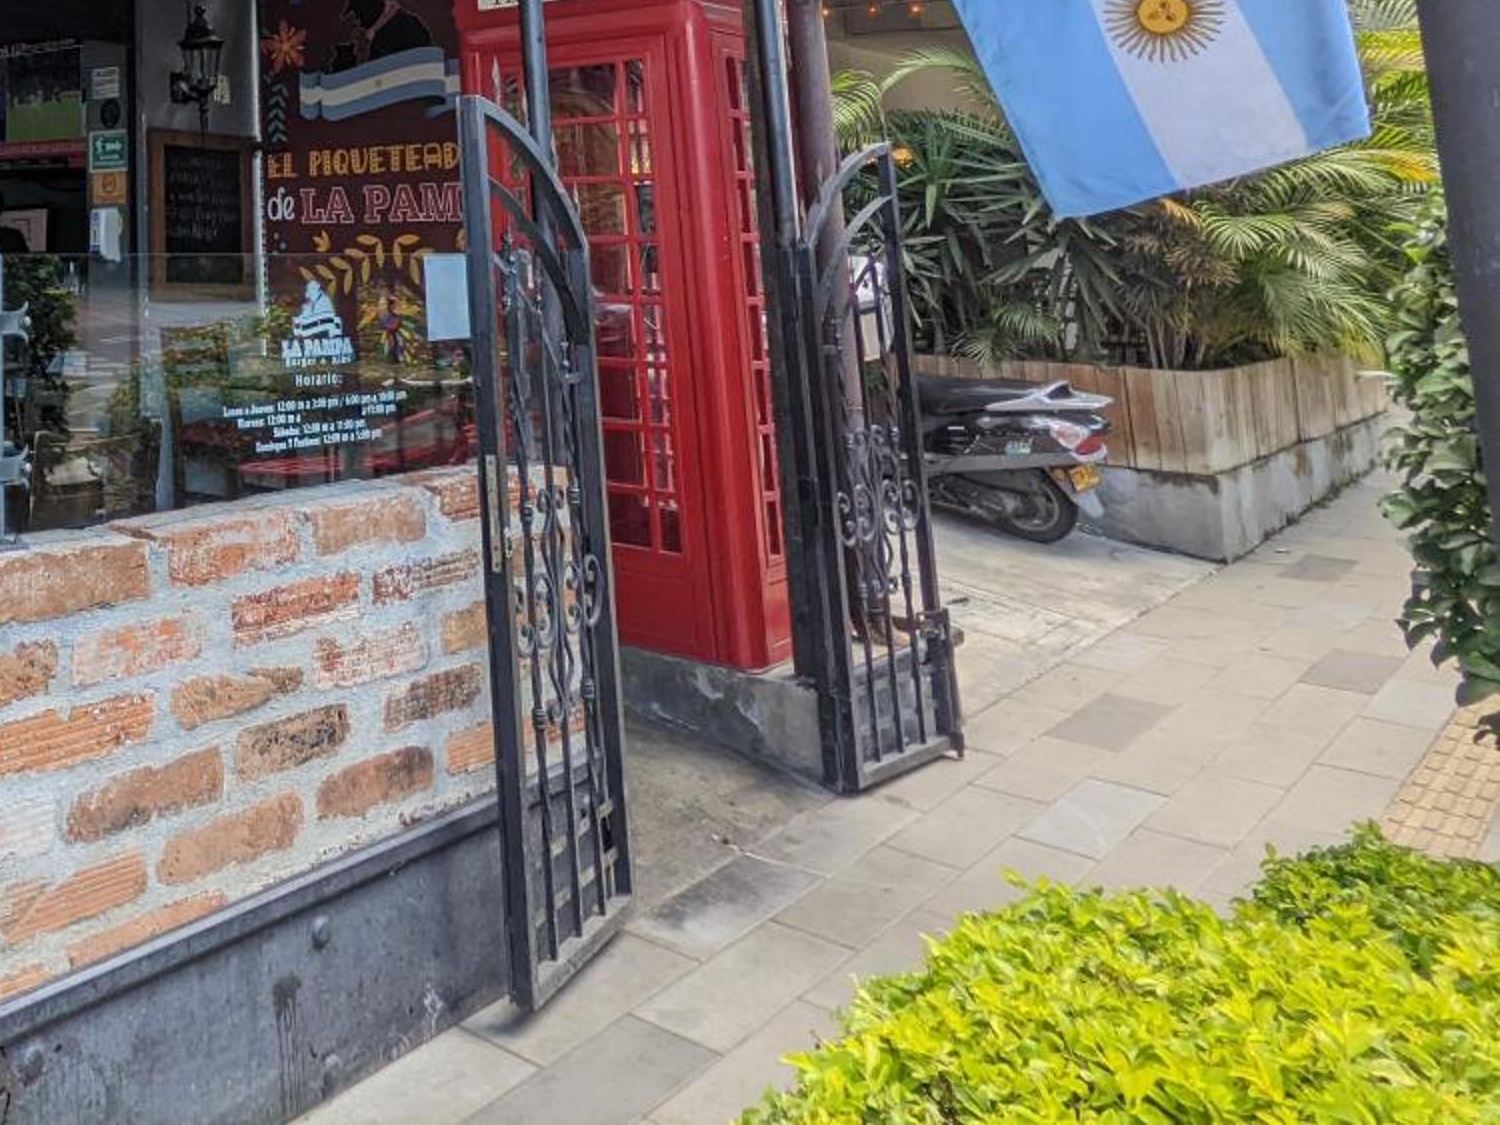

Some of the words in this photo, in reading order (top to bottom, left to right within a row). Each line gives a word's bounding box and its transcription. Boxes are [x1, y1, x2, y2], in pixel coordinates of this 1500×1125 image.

[267, 152, 297, 178] EL
[309, 142, 460, 176] PIQUETEAD
[267, 187, 295, 221] de
[300, 186, 355, 224] LA
[362, 182, 464, 223] PAM
